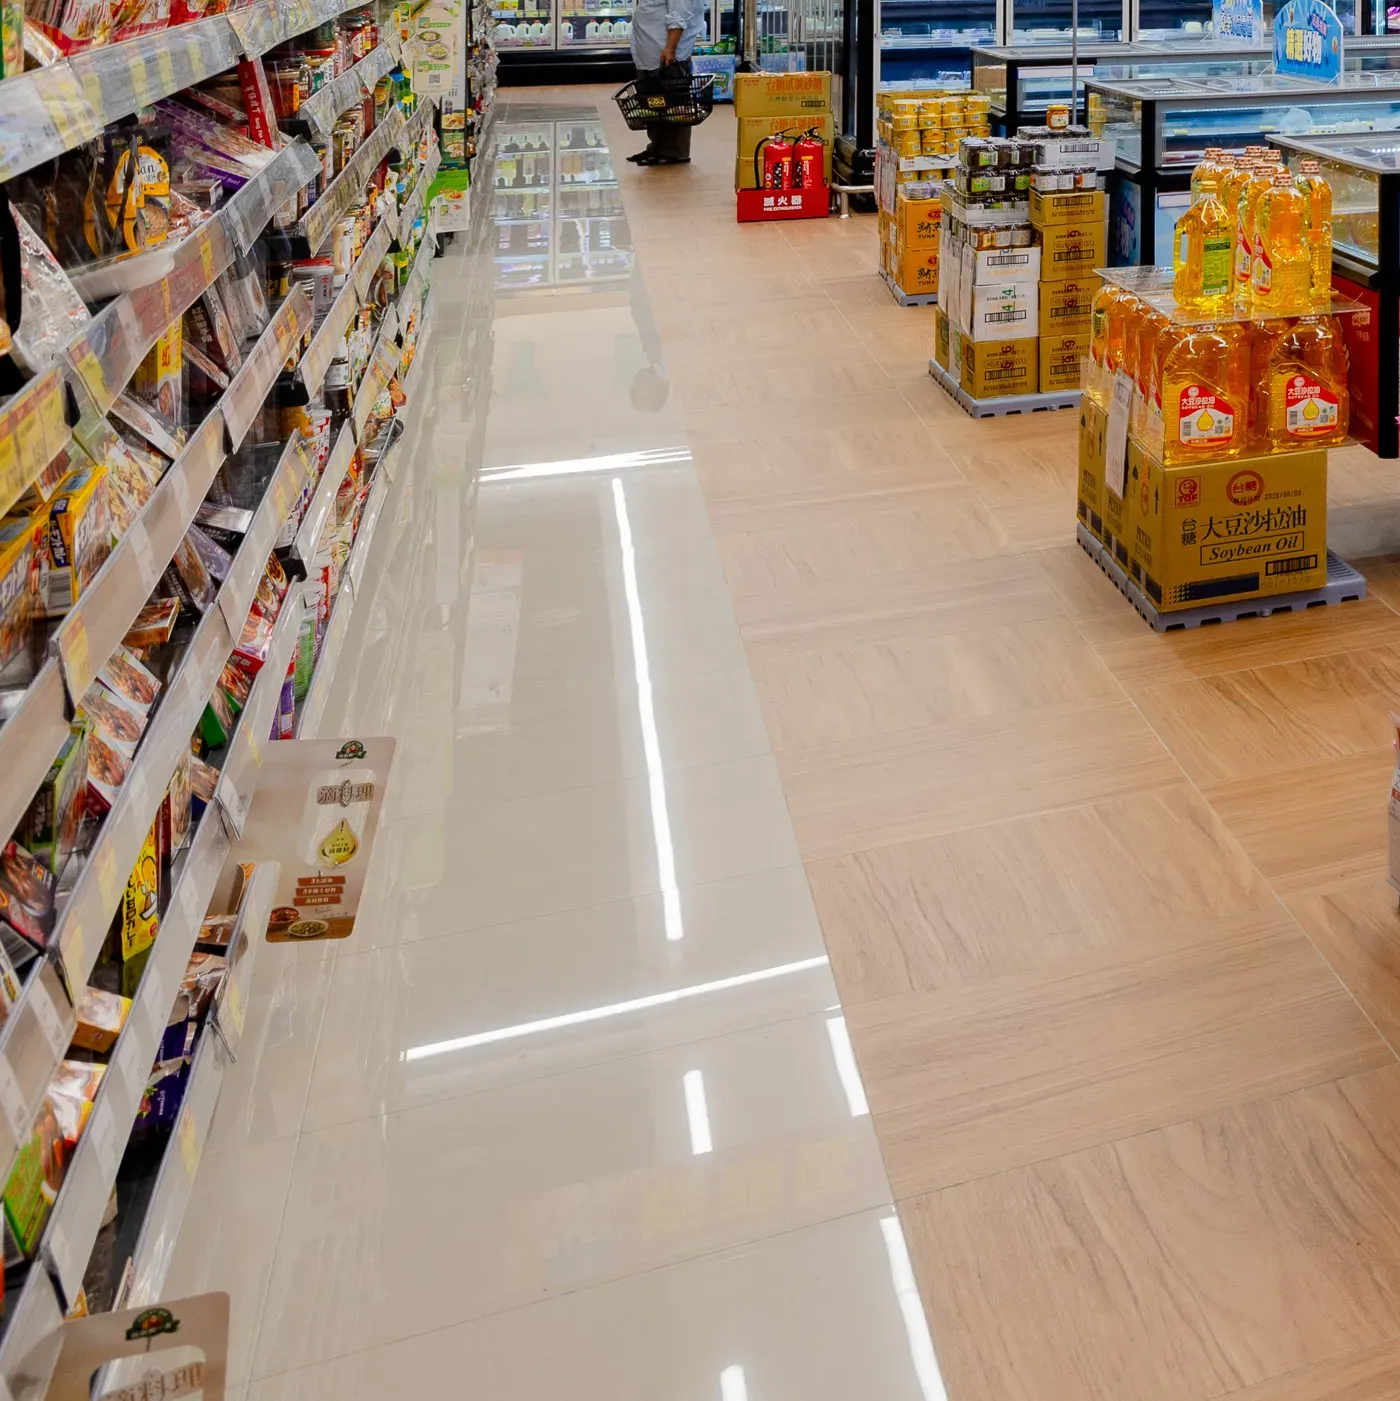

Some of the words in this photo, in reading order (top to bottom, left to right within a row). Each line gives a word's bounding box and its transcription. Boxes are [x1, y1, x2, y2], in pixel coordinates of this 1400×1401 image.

[763, 195, 802, 207] 滅火器
[1178, 493, 1198, 502] TQF
[1233, 480, 1258, 494] 台糖
[1181, 517, 1197, 547] 台糖
[1200, 504, 1308, 543] 大豆沙拉油
[1208, 541, 1271, 562] Soybean
[1276, 535, 1299, 550] Oil
[319, 783, 373, 804] 滴料理
